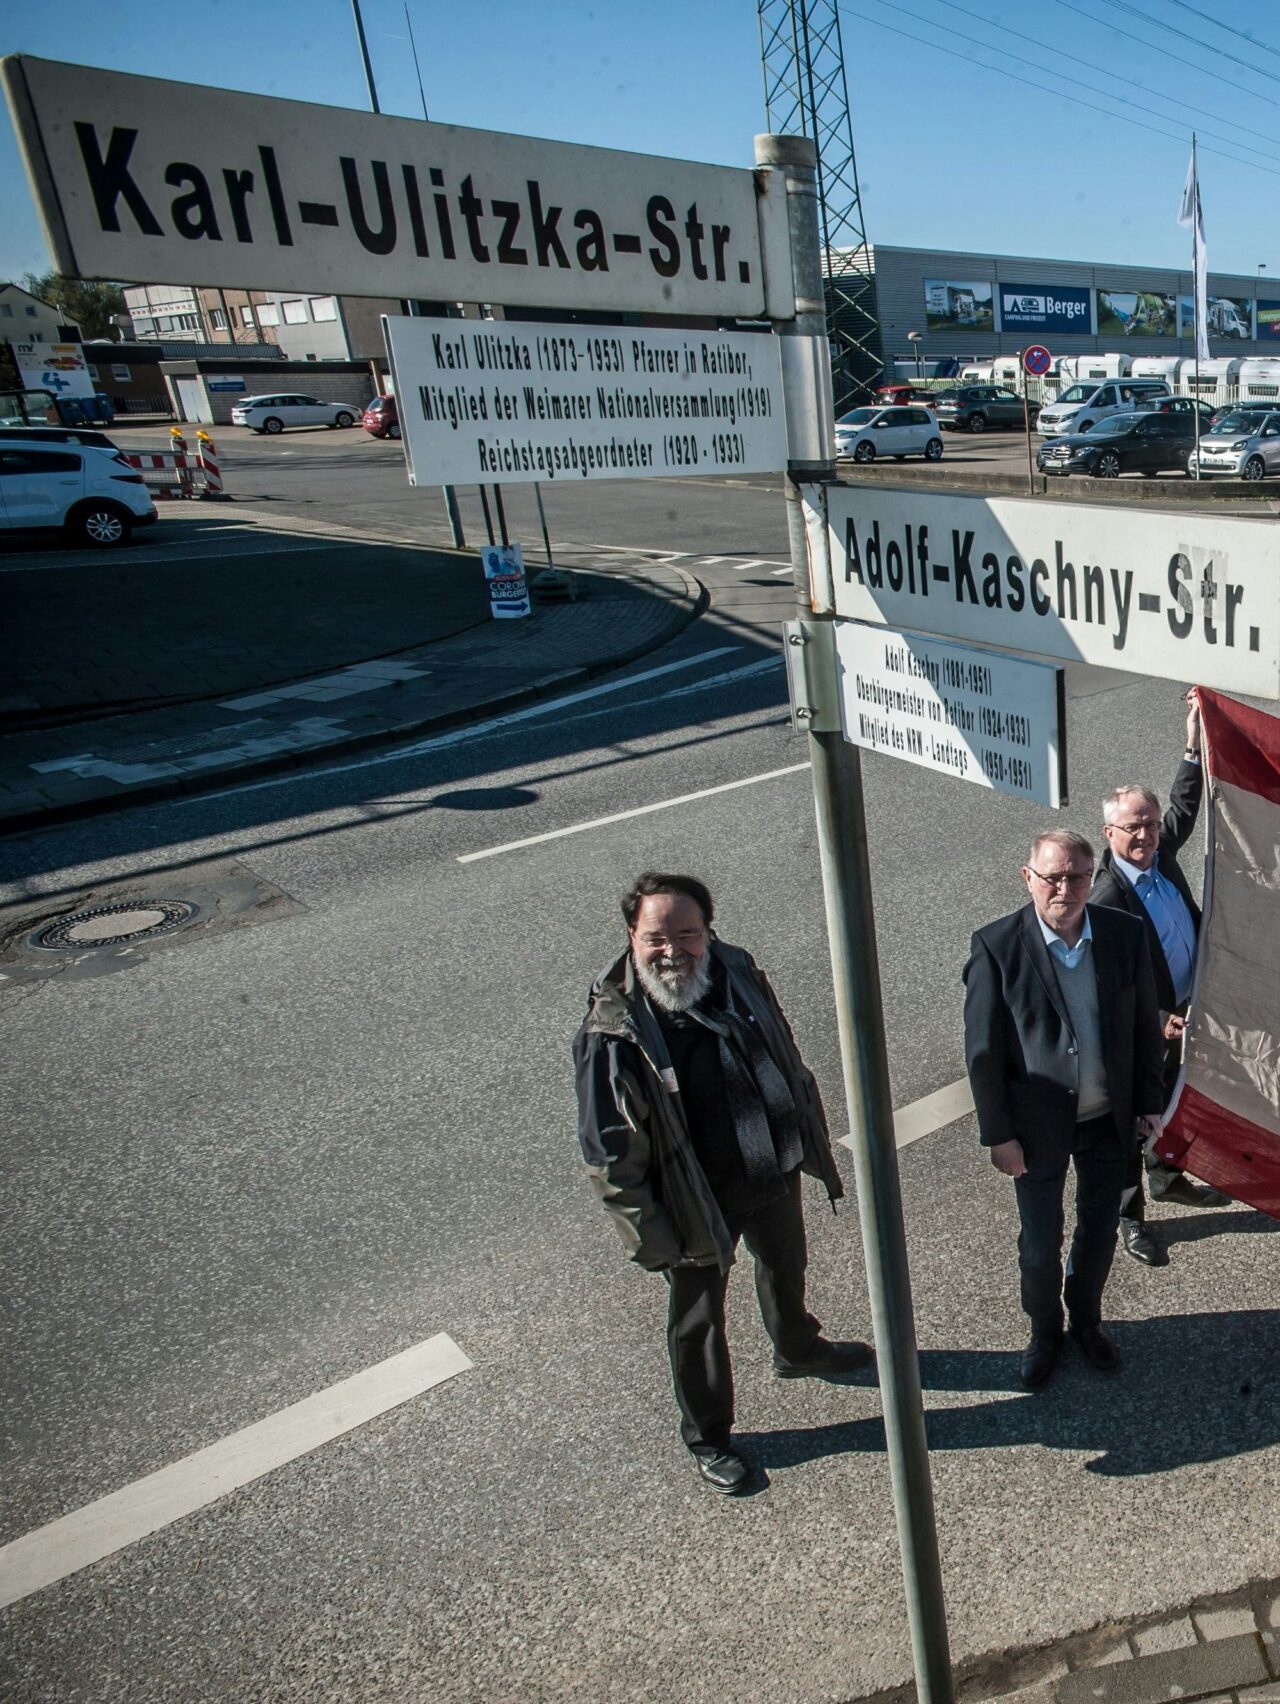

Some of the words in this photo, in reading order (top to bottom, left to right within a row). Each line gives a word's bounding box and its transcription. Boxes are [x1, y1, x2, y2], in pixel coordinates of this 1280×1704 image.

[74, 121, 751, 284] Karl-Ulitzka-Str.
[1046, 296, 1087, 319] Berger
[432, 333, 469, 370] Karl
[473, 334, 532, 371] Ulitzka
[632, 340, 679, 374] Pfarrer
[684, 342, 697, 374] in
[701, 343, 753, 382] Ratibor,
[418, 385, 489, 430] Mitglied
[494, 387, 518, 421] der
[522, 387, 592, 420] Weimarer
[478, 434, 655, 479] Reichstagsabgeordneter
[663, 435, 698, 466] (1920
[712, 433, 745, 464] 1933)
[844, 516, 1261, 653] Adolf-Kaschny-Str.
[885, 644, 905, 674] Adolf
[907, 650, 940, 690] Kaschny
[942, 656, 993, 697] (1881-1951)
[856, 673, 925, 719] Oberbürgermeister
[927, 701, 942, 722] von
[944, 698, 975, 730] Ratibor
[978, 706, 1031, 748] (1924-1933)
[859, 713, 889, 749] Mitglied
[891, 723, 905, 751] des
[907, 727, 923, 756] NRW
[931, 735, 968, 776] Landtags
[981, 748, 1032, 791] (1950-1951)
